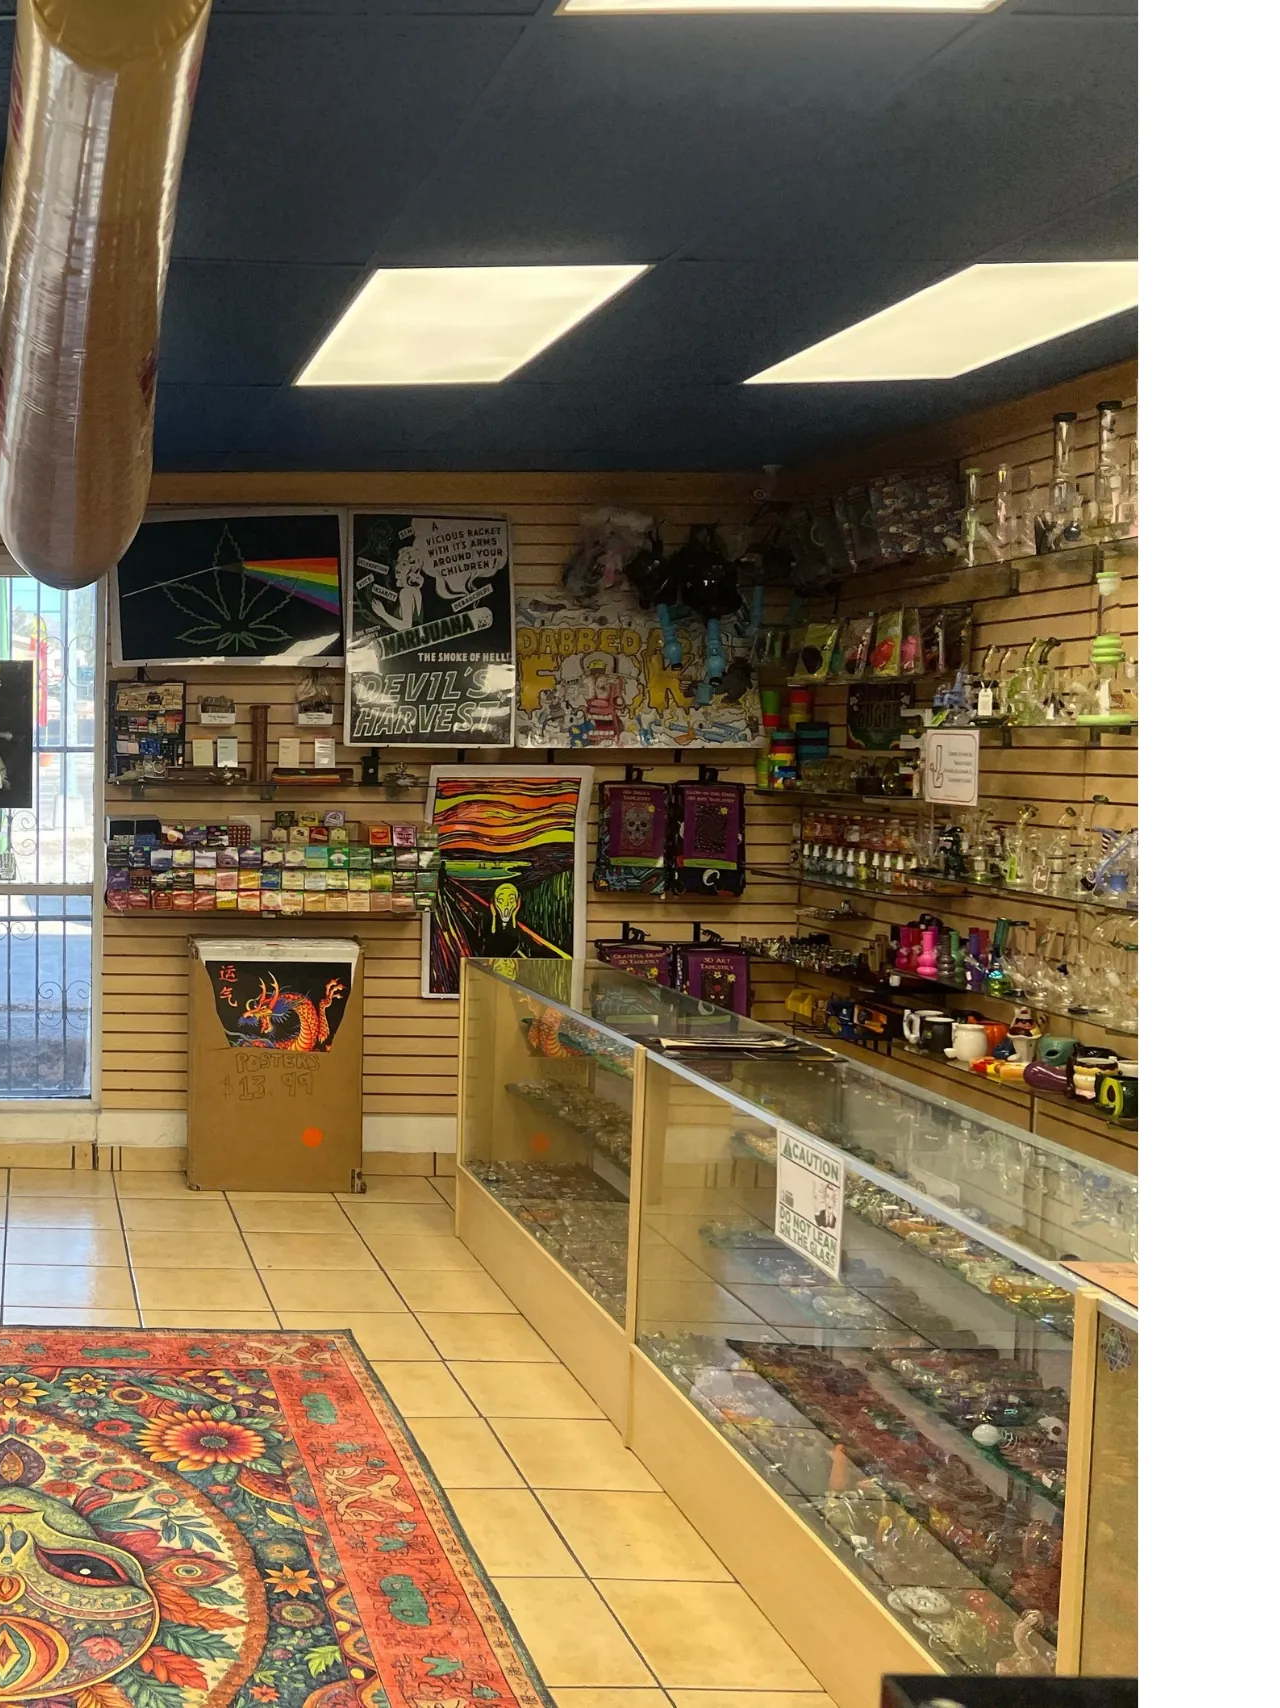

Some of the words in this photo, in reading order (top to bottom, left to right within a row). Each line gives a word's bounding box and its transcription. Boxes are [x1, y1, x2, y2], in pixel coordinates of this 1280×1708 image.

[425, 531, 465, 546] VICIOUS
[467, 527, 501, 537] RACKET
[432, 521, 439, 532] A
[427, 546, 450, 557] WITH
[470, 537, 497, 548] ARMS
[433, 551, 471, 568] AROUND
[476, 548, 503, 558] YOUR
[373, 585, 398, 600] INSANITY
[381, 612, 475, 656] MARIJUANA
[517, 627, 641, 657] DABBED
[417, 652, 431, 662] THE
[438, 652, 468, 662] SMOKE
[470, 652, 480, 662] OF
[353, 700, 501, 737] HARVEST
[219, 965, 239, 1007] 运气
[235, 1051, 320, 1074] POSTERS
[792, 1141, 839, 1182] CAUTION
[779, 1205, 791, 1224] DO
[793, 1216, 812, 1237] NOT
[813, 1229, 837, 1255] LEAN
[779, 1222, 791, 1238] ON
[792, 1230, 808, 1250] THE
[809, 1241, 836, 1268] GLASS
